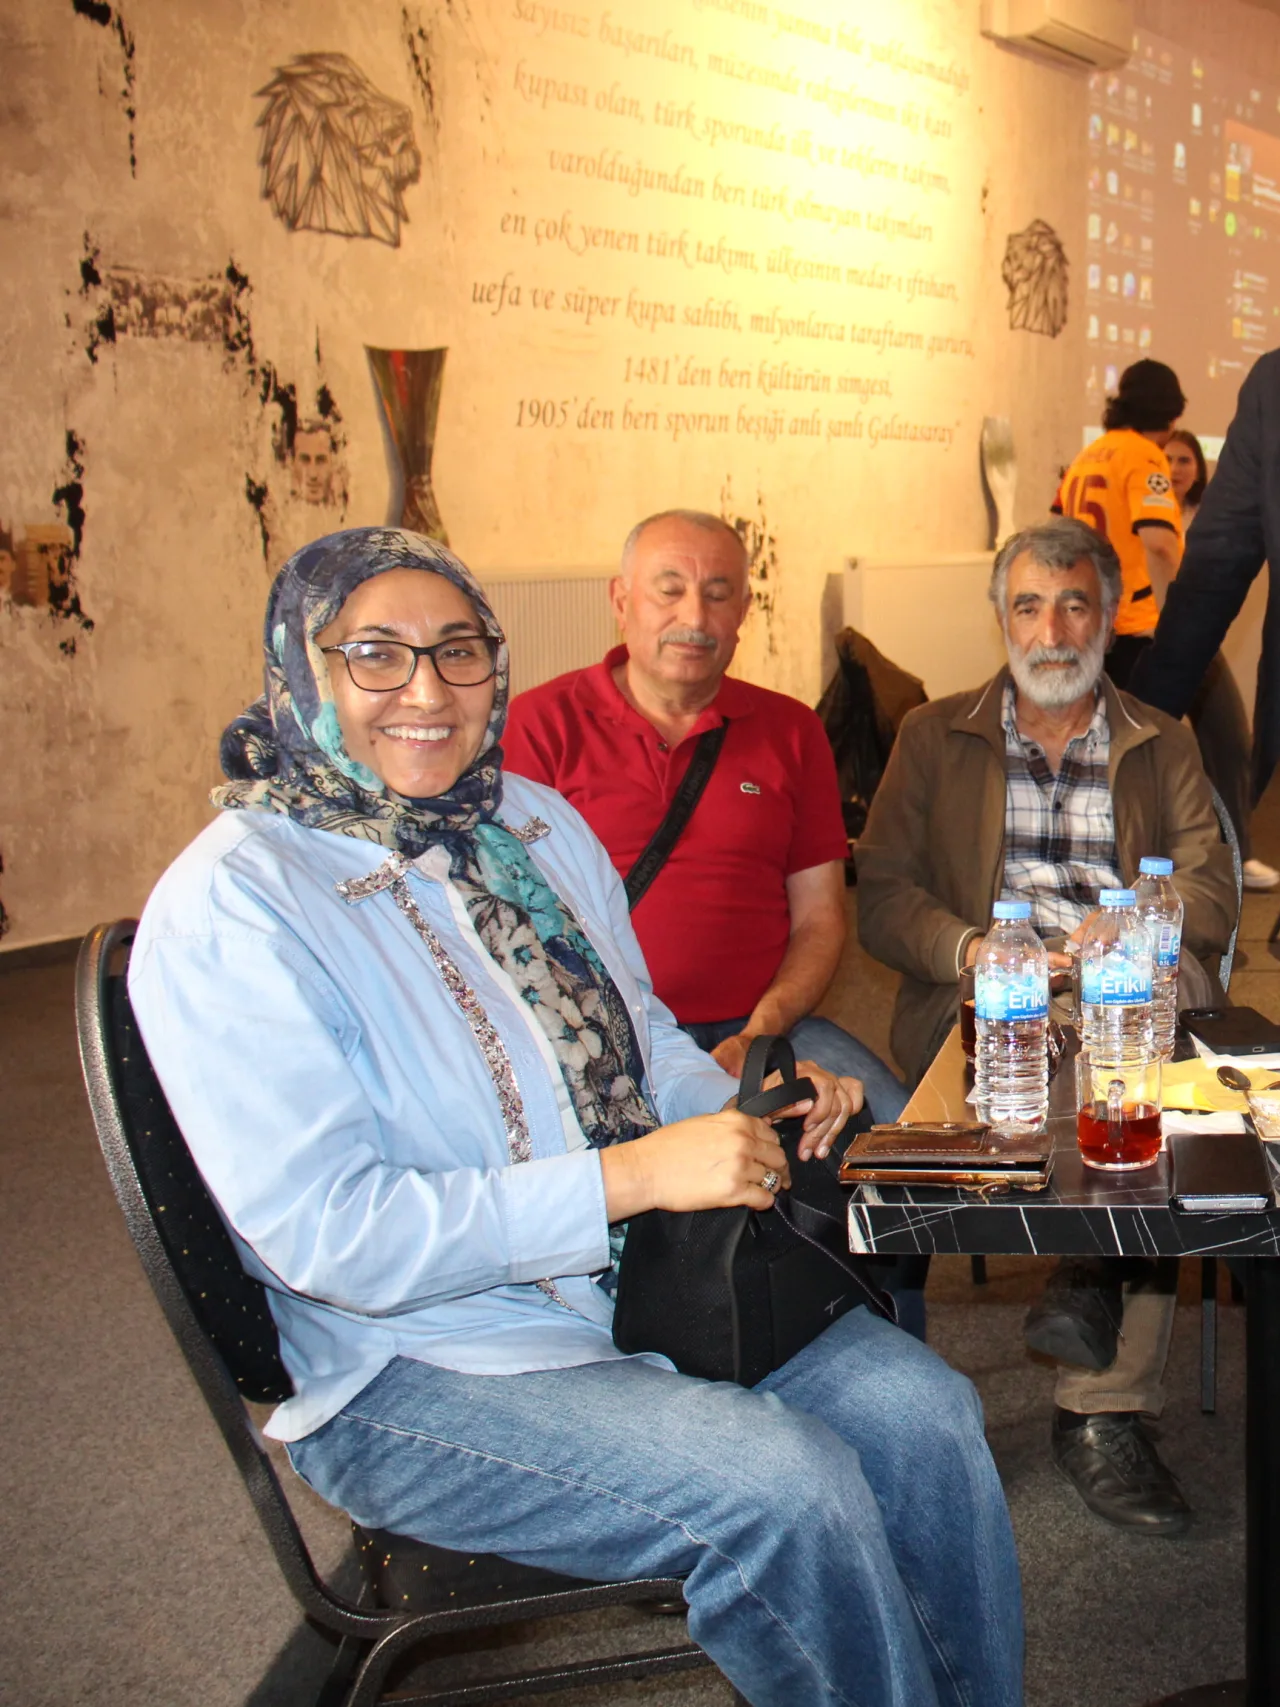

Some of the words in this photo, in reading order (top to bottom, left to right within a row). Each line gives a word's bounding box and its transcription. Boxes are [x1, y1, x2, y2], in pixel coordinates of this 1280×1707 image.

[514, 57, 588, 110] kupası
[595, 80, 645, 125] olan,
[654, 101, 702, 141] türk
[704, 116, 786, 152] sporunda
[549, 148, 705, 198] varolduğundan
[712, 169, 747, 206] beri
[752, 184, 793, 223] türk
[500, 211, 526, 236] en
[534, 208, 580, 255] çok
[578, 223, 639, 256] yenen
[647, 228, 694, 269] türk
[696, 234, 759, 274] takımı,
[471, 271, 521, 316] uefa
[531, 287, 556, 311] ve
[561, 285, 623, 325] süper
[626, 286, 675, 333] kupa
[682, 296, 742, 333] sahibi,
[750, 305, 845, 345] milyonlarca
[623, 353, 711, 386] 1481'den
[718, 357, 753, 389] beri
[757, 359, 831, 397] kültürün
[515, 396, 614, 430] 1905'den
[622, 398, 661, 431] beri
[664, 411, 730, 442] sporun
[736, 404, 787, 444] beşiği
[788, 408, 821, 436] anlı
